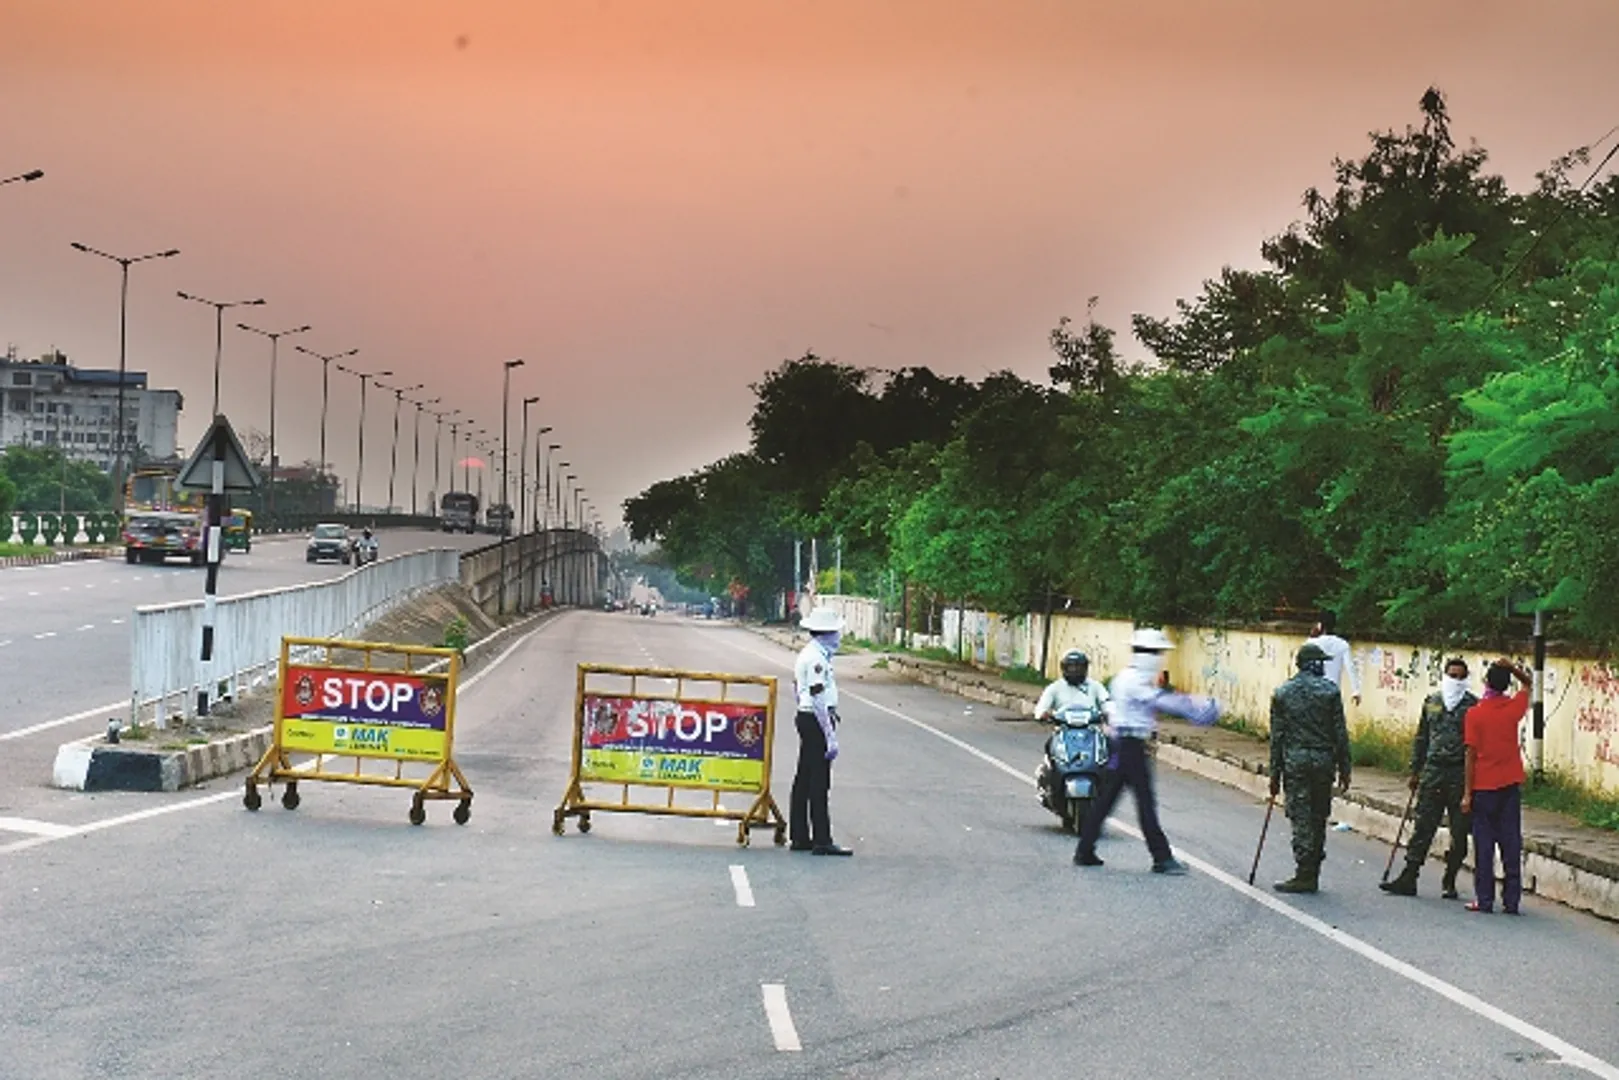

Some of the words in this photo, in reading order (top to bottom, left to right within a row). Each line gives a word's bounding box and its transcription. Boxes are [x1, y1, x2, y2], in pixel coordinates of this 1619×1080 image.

[322, 677, 413, 712] STOP
[626, 701, 727, 742] STOP
[351, 728, 388, 743] MAK
[660, 757, 702, 772] MAK
